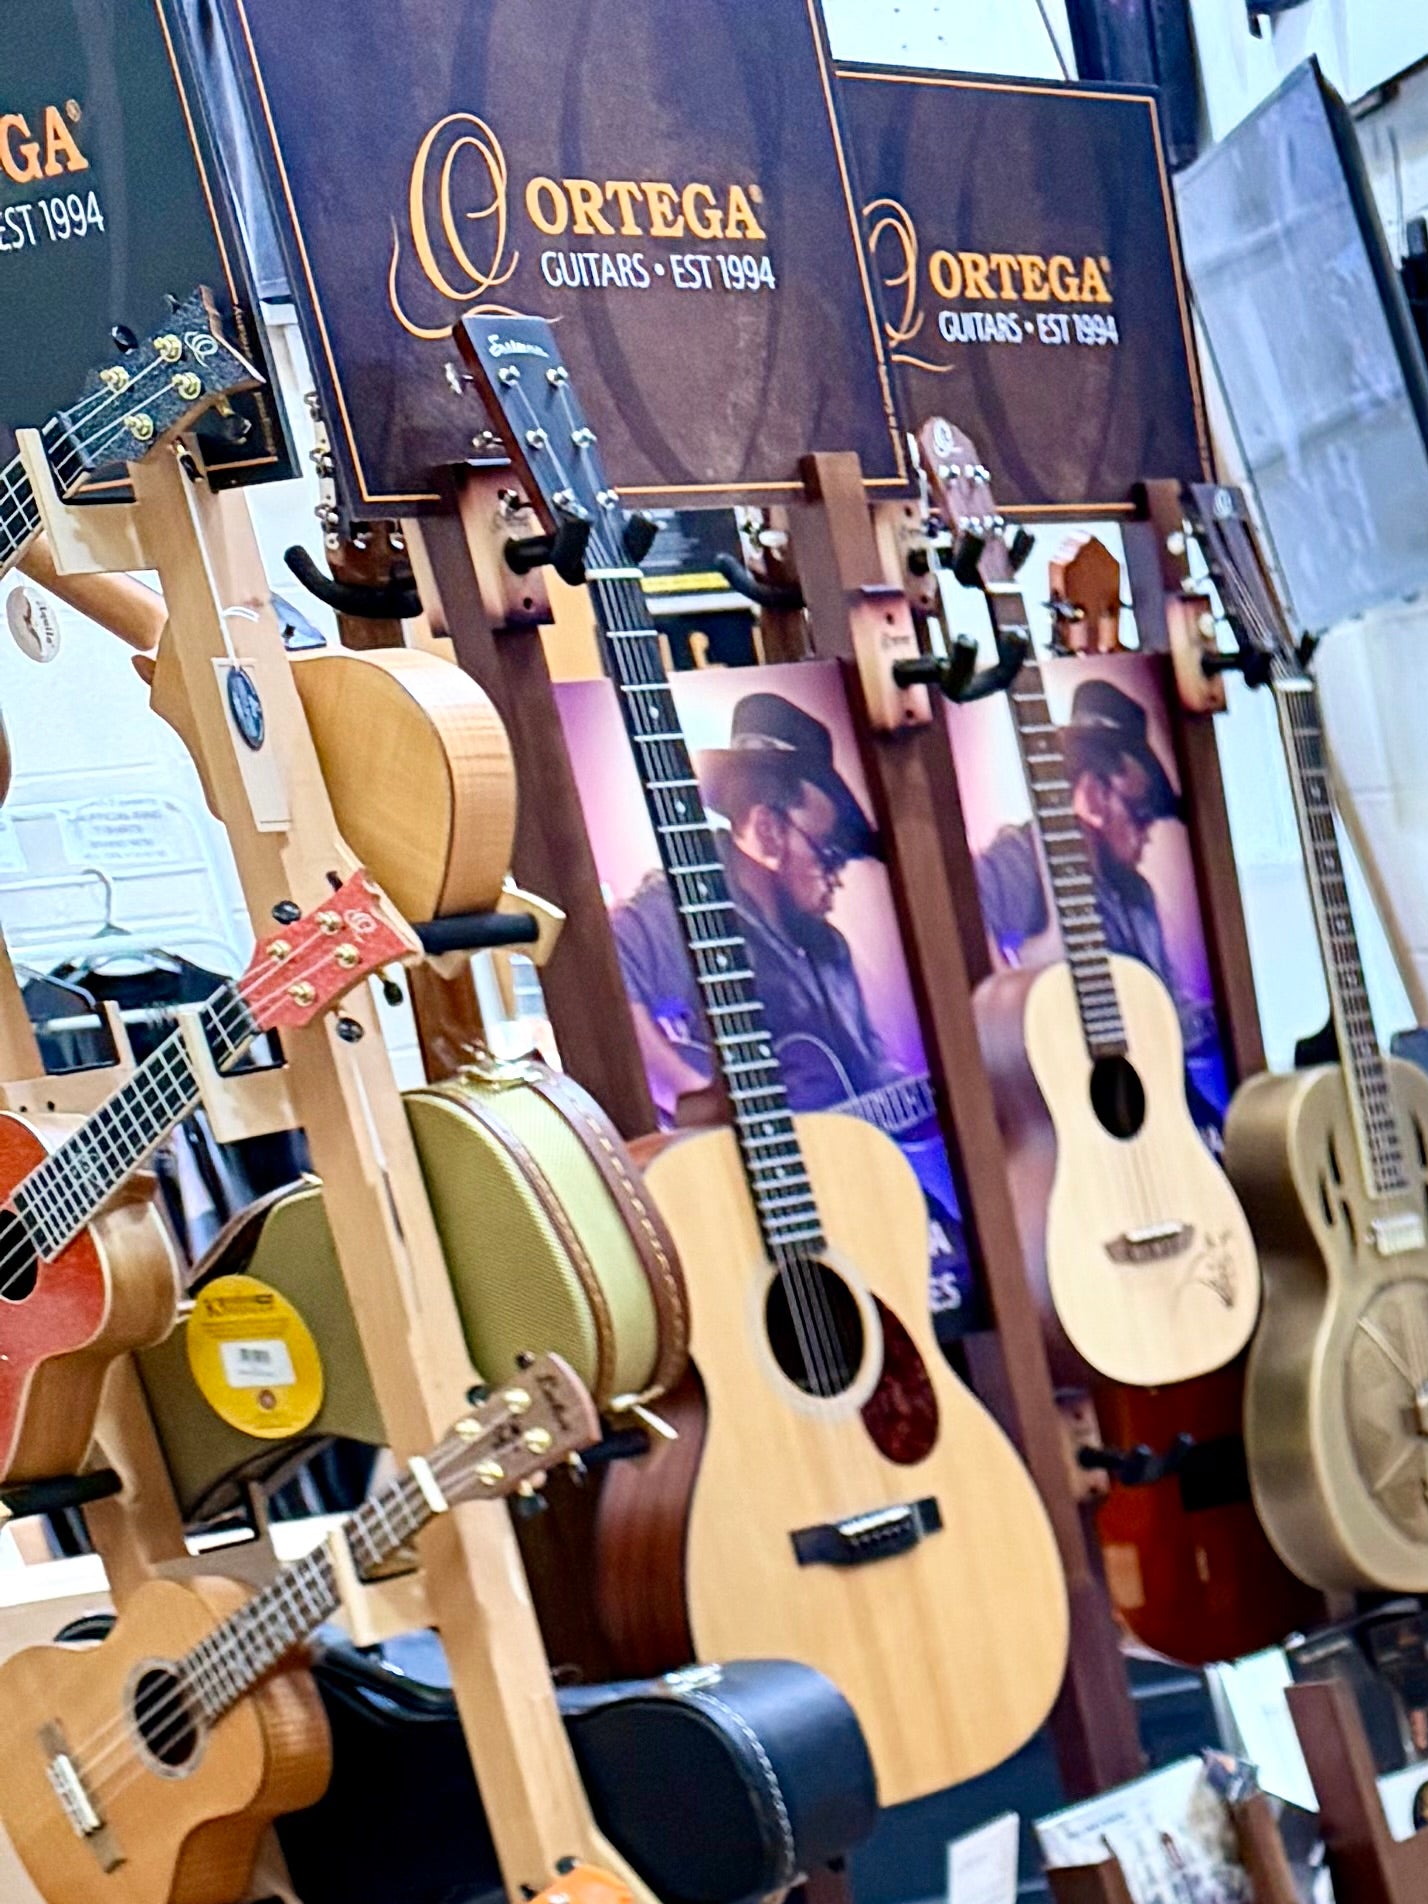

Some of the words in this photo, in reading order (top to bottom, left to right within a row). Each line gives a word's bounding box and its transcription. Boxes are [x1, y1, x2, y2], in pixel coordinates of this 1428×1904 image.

[42, 190, 104, 241] 1994
[525, 177, 766, 240] ORTEGA
[541, 251, 650, 288] GUITARS
[671, 255, 712, 289] EST
[718, 255, 776, 290] 1994
[929, 250, 1112, 303] ORTEGA
[938, 311, 1023, 343] GUITARS
[1036, 313, 1070, 345] EST
[1072, 314, 1119, 346] 1994
